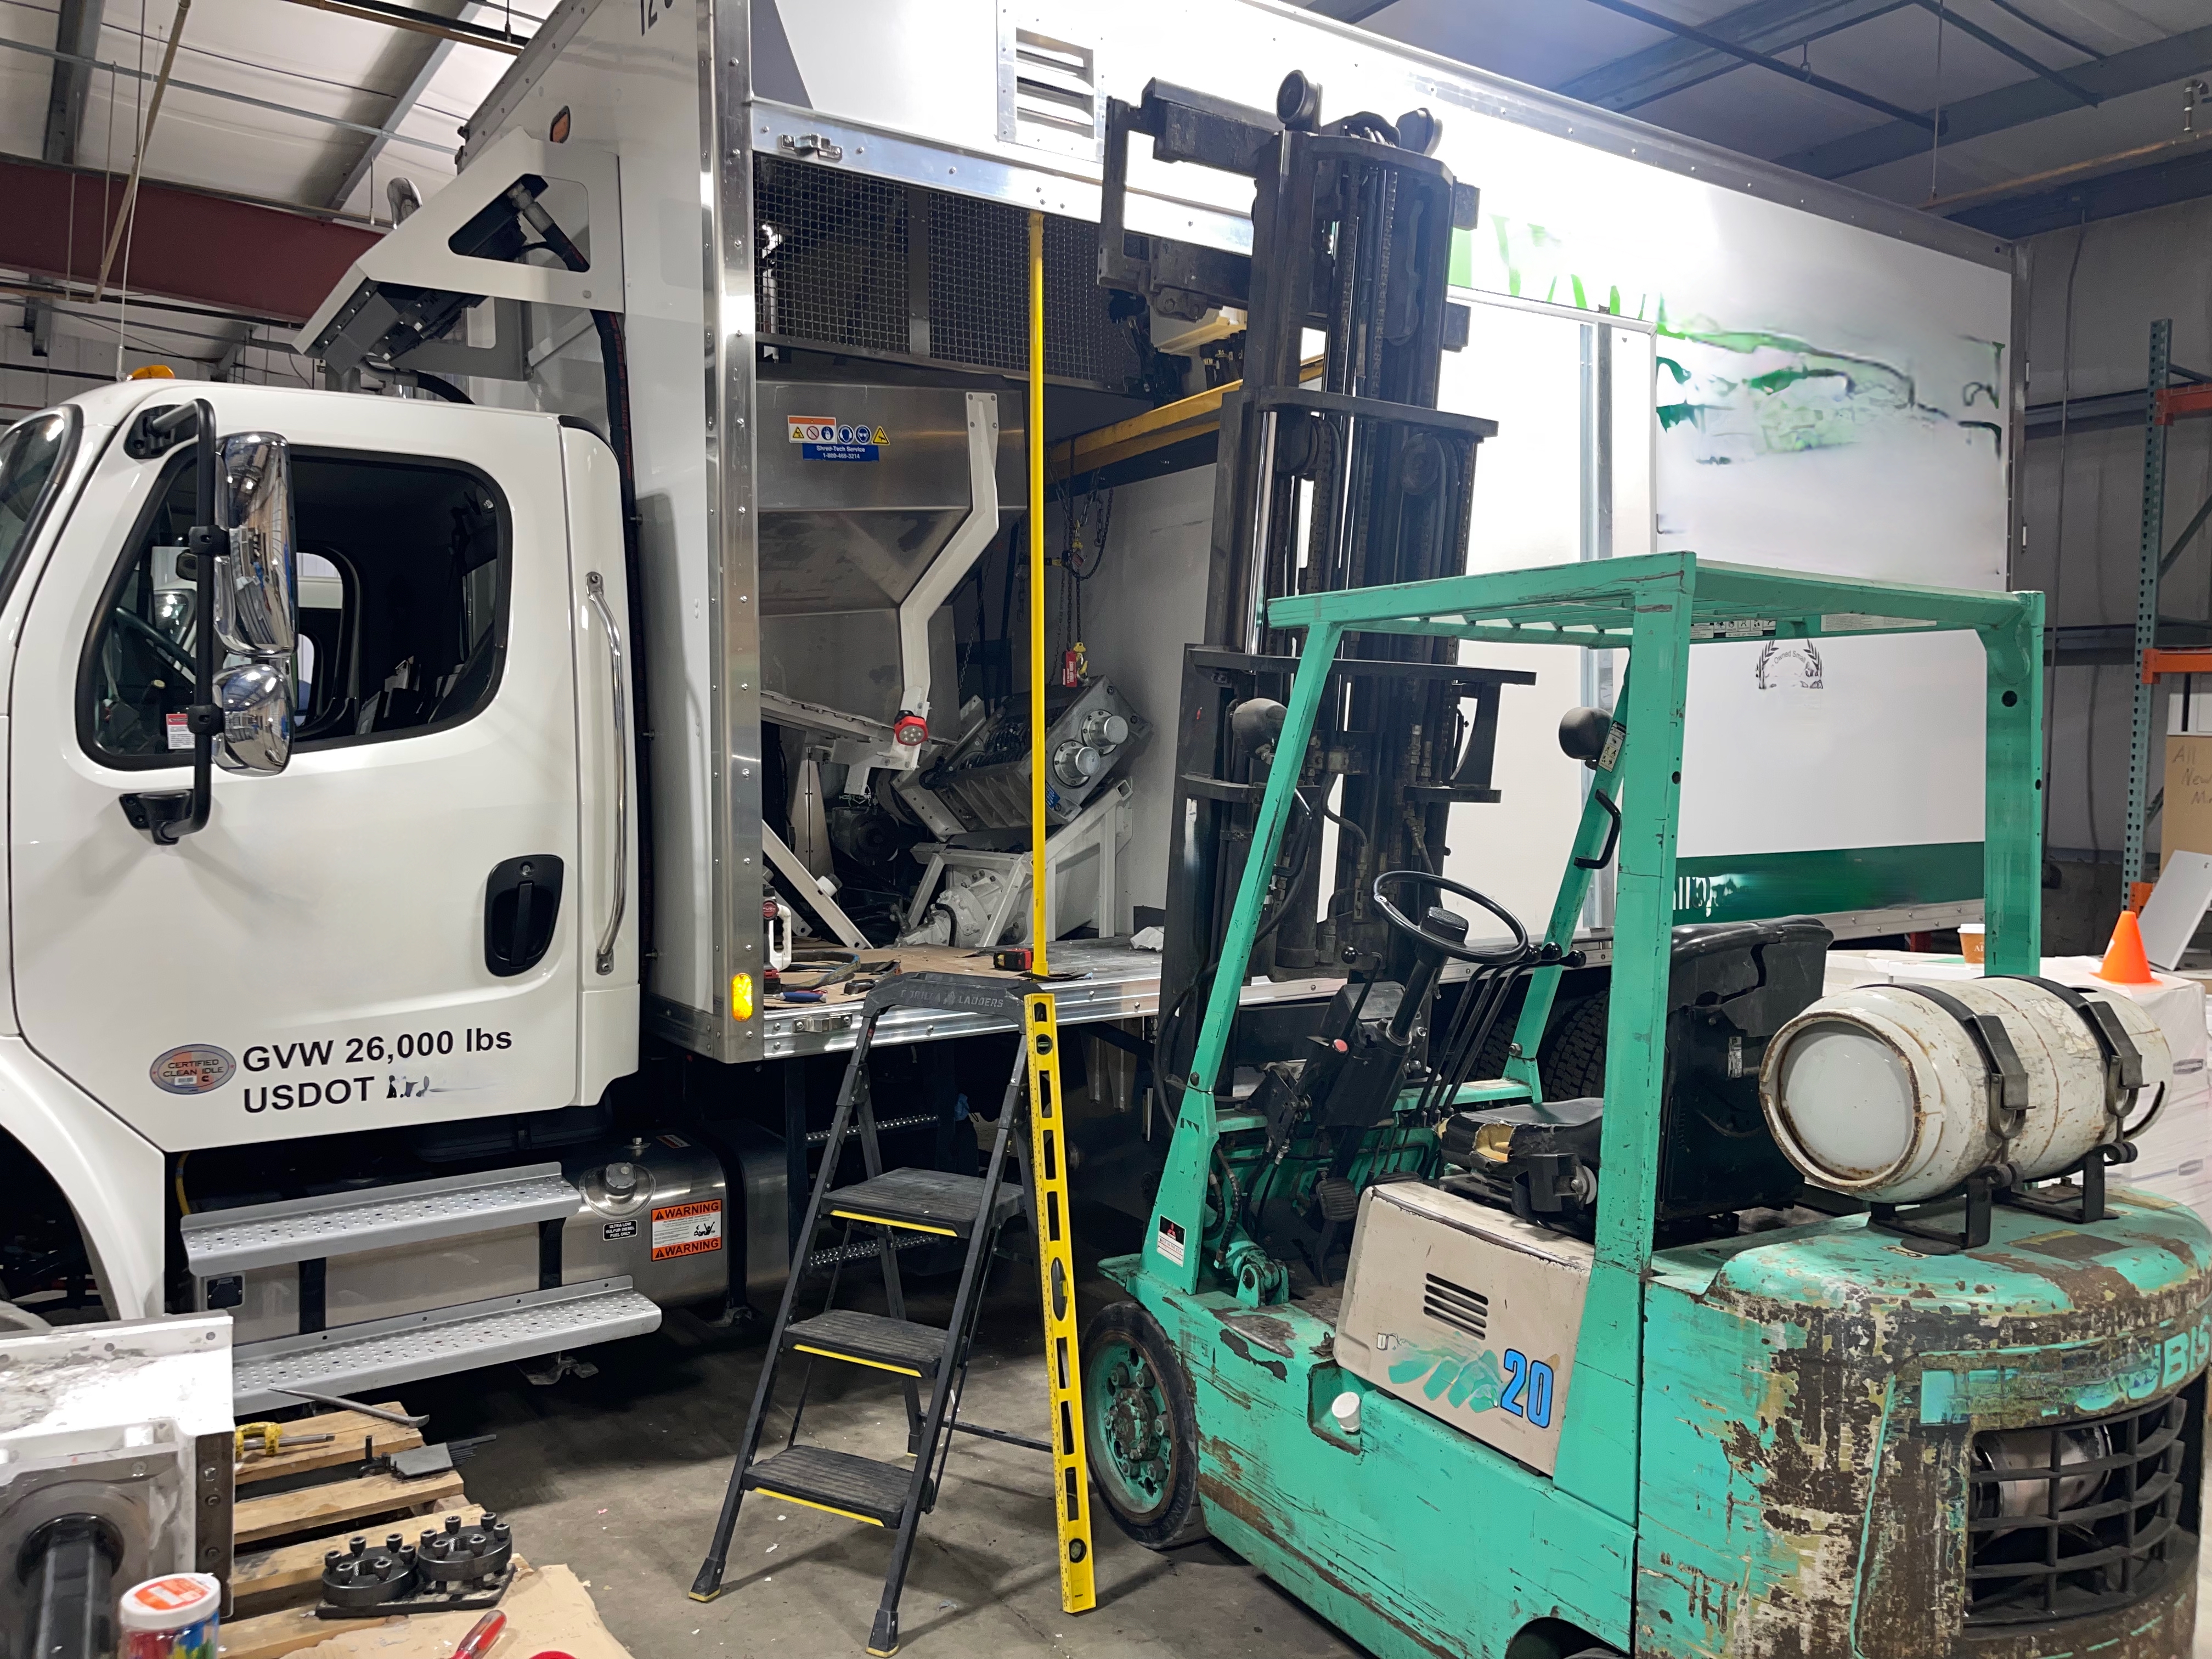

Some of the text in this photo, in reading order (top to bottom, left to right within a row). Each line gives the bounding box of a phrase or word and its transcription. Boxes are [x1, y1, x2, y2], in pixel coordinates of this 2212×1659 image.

[1774, 650, 1791, 664] Owned
[2172, 745, 2196, 763] All
[959, 995, 1003, 1008] LADDERS
[243, 1027, 512, 1072] GVW 26,000 lbs
[168, 1059, 219, 1069] CERTIFIED
[244, 1076, 375, 1114] USDOT
[665, 1202, 719, 1218] WARNING
[665, 1239, 719, 1256] WARNING
[1500, 1348, 1554, 1429] 20
